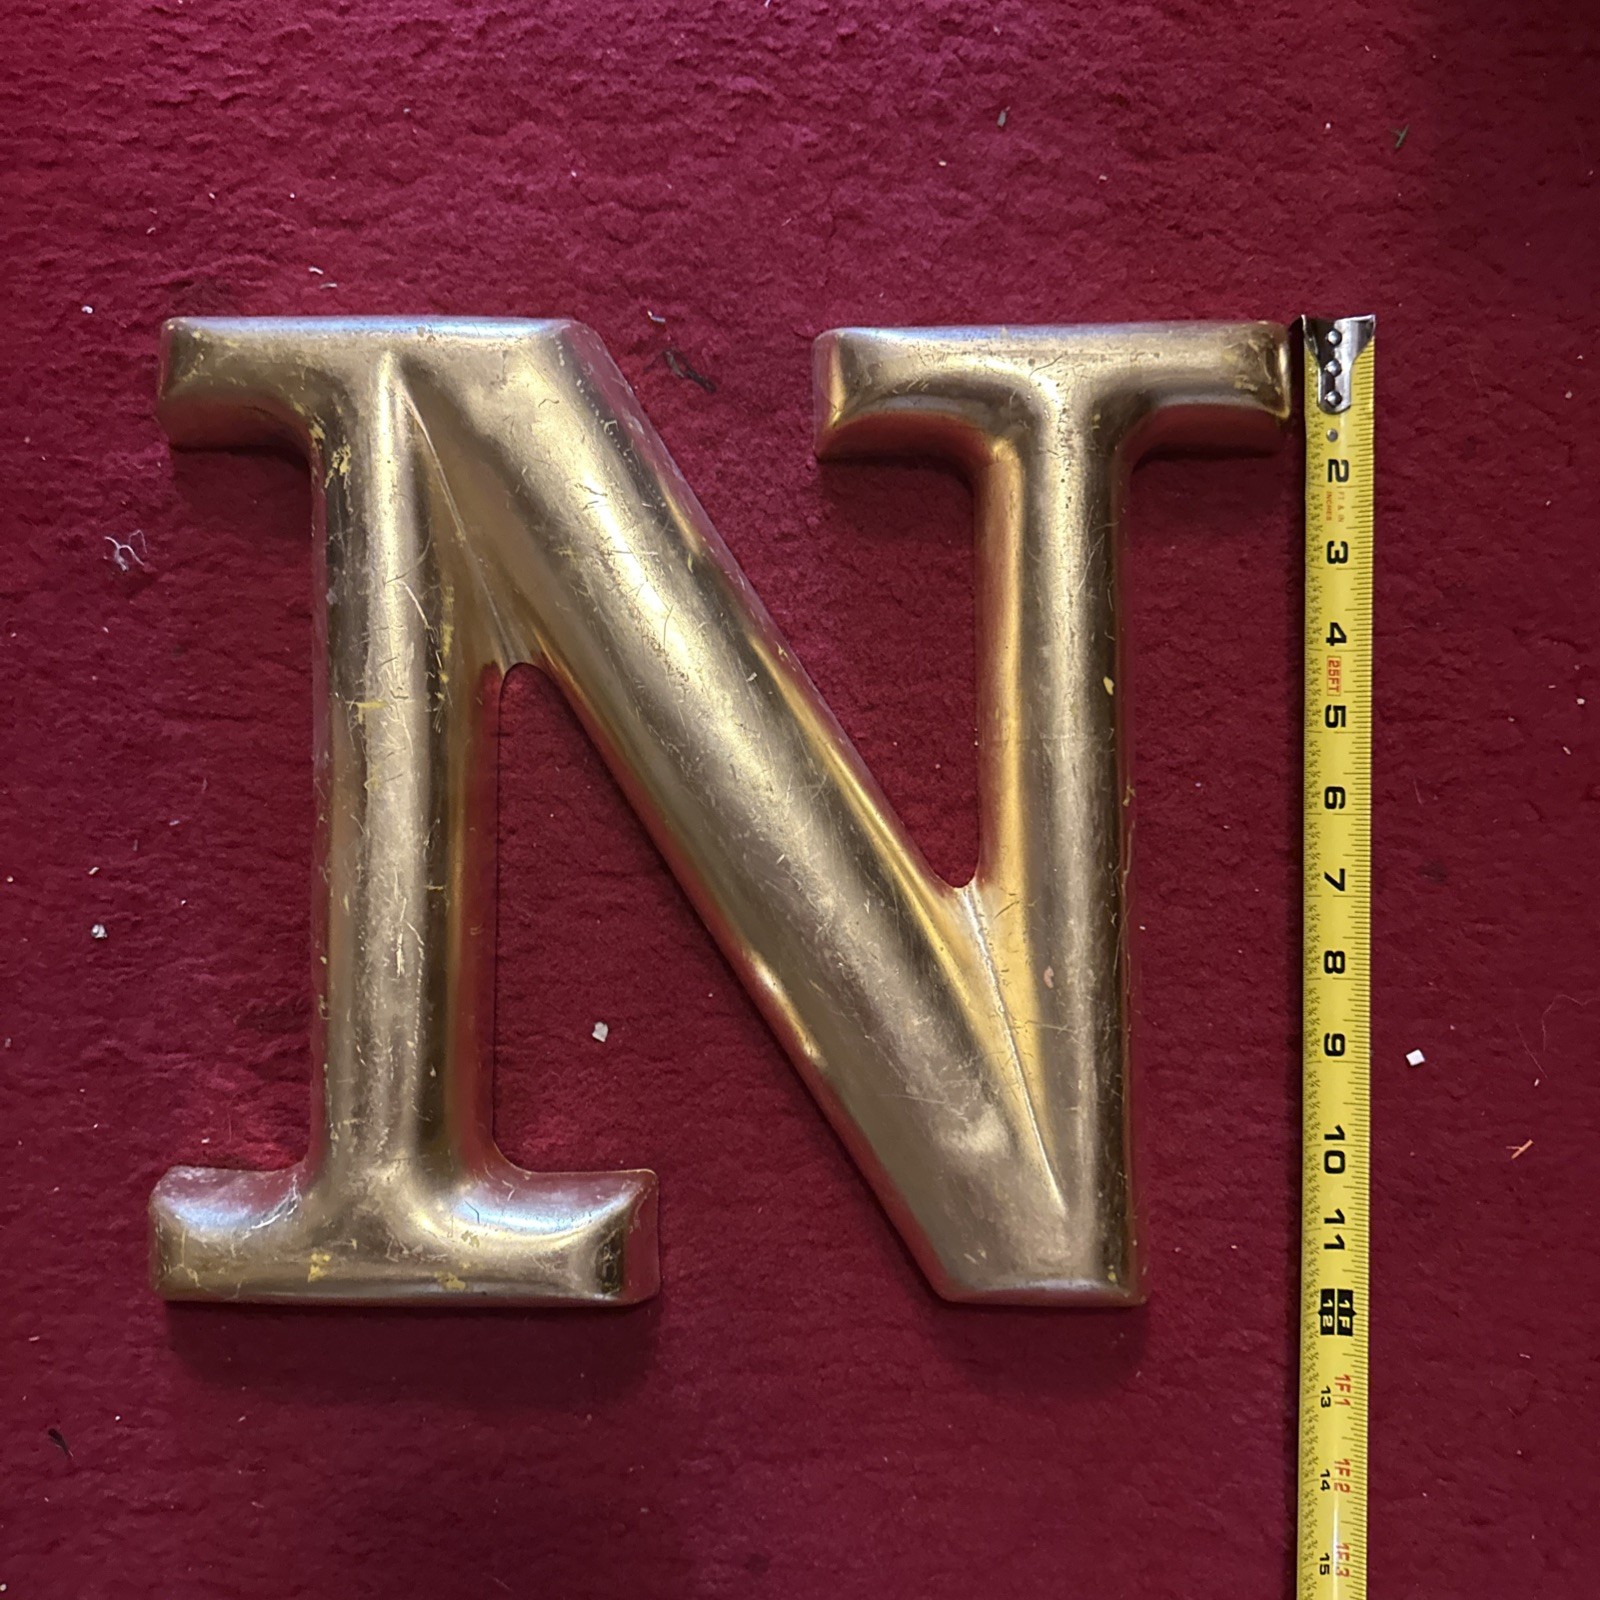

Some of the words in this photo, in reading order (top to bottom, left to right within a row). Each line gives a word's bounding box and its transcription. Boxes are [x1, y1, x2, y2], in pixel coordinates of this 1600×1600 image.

[1327, 458, 1350, 483] 2
[1325, 490, 1333, 522] INCHES
[1326, 540, 1349, 564] 3
[1325, 622, 1347, 647] 4
[1327, 659, 1341, 693] 25FT
[1324, 704, 1346, 729] 5
[150, 314, 1292, 1305] N
[1324, 786, 1346, 810] 6
[1324, 868, 1345, 891] 7
[1324, 950, 1346, 974] 8
[1324, 1033, 1346, 1057] 9
[1324, 1125, 1345, 1175] 10
[1324, 1208, 1345, 1250] 11
[1322, 1299, 1333, 1328] 12
[1320, 1385, 1331, 1409] 13
[1319, 1469, 1331, 1492] 14
[1319, 1552, 1330, 1576] 15
